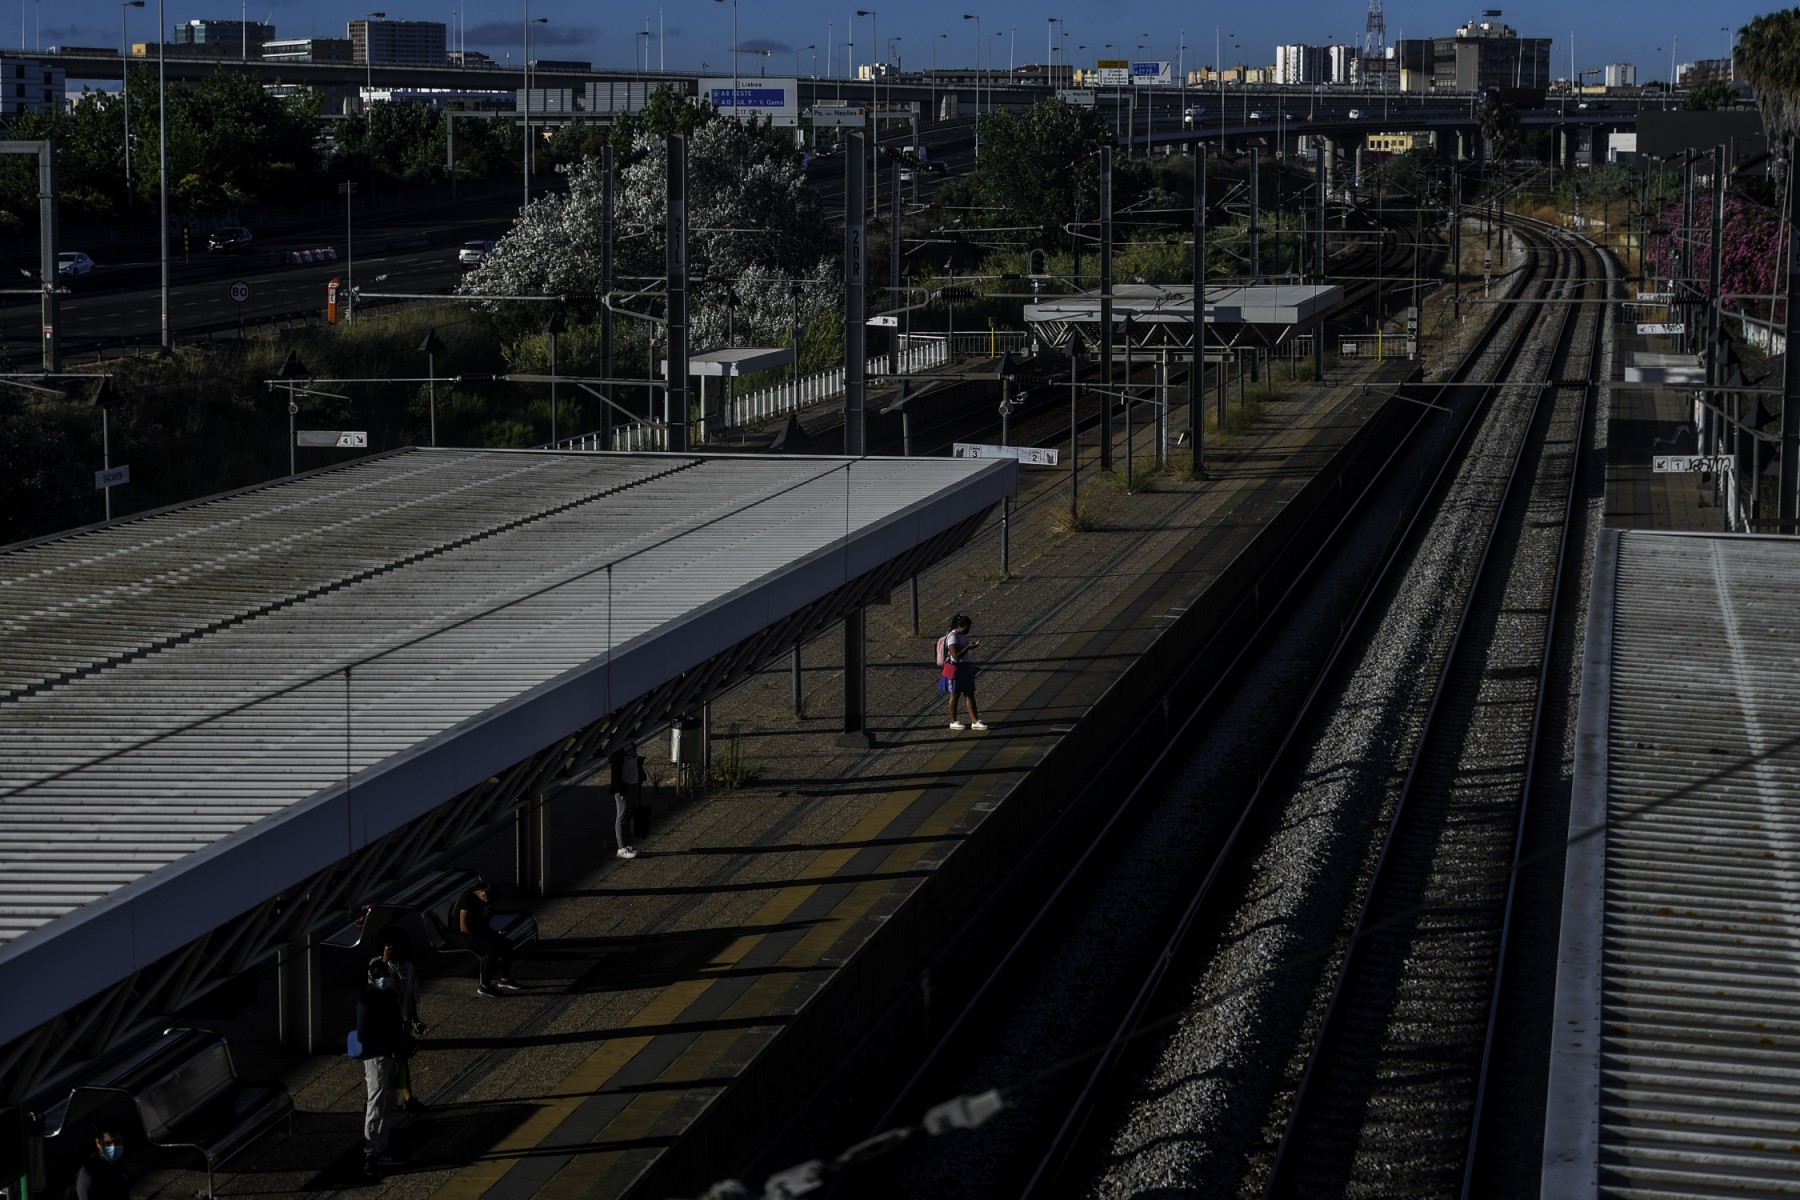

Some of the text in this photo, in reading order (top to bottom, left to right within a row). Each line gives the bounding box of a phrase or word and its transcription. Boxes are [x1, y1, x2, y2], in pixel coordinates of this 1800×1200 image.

[852, 230, 860, 276] 20R
[232, 287, 247, 296] 80
[1032, 454, 1038, 462] 2
[1675, 462, 1680, 470] 1
